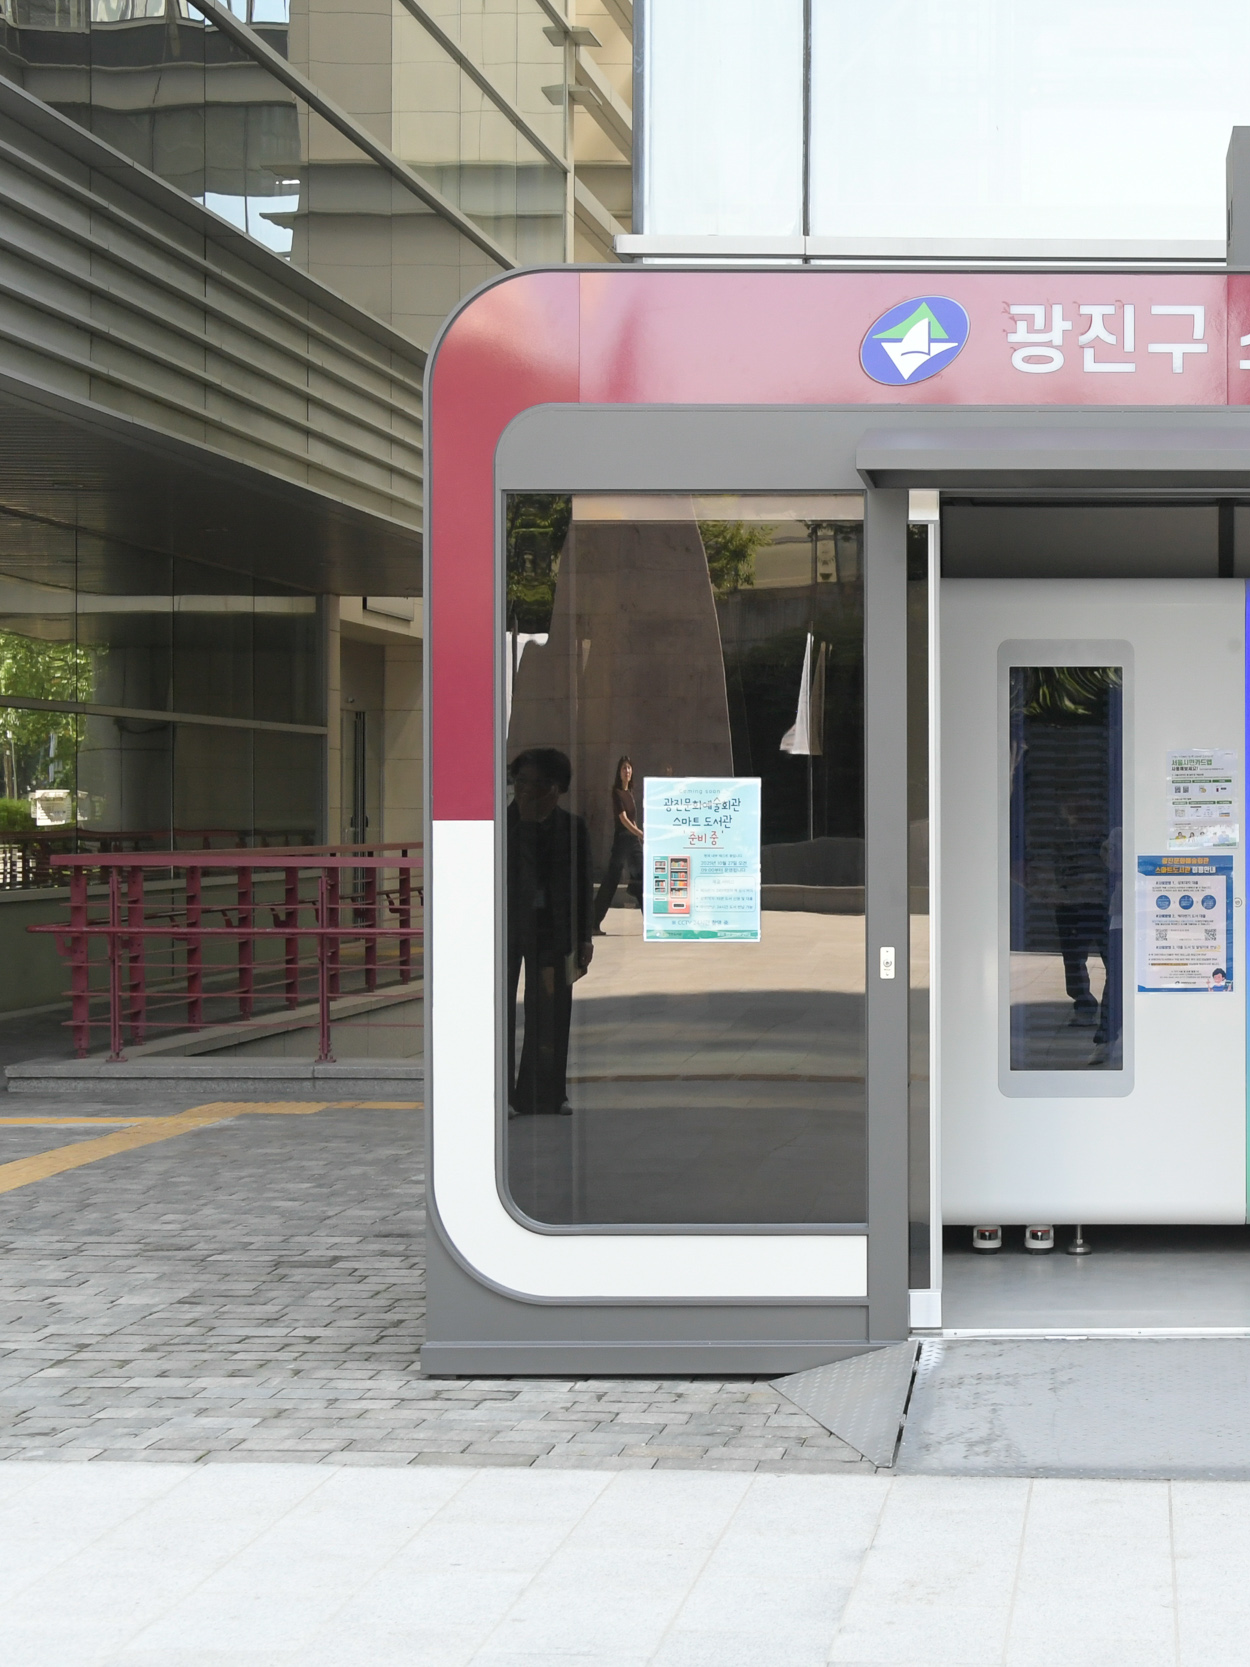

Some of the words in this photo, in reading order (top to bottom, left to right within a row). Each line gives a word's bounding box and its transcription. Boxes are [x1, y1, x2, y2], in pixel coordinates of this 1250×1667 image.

[1007, 304, 1208, 374] 광진구
[663, 797, 741, 812] 광진문화예술회관
[672, 816, 701, 827] 스마트
[703, 814, 733, 829] 도서관
